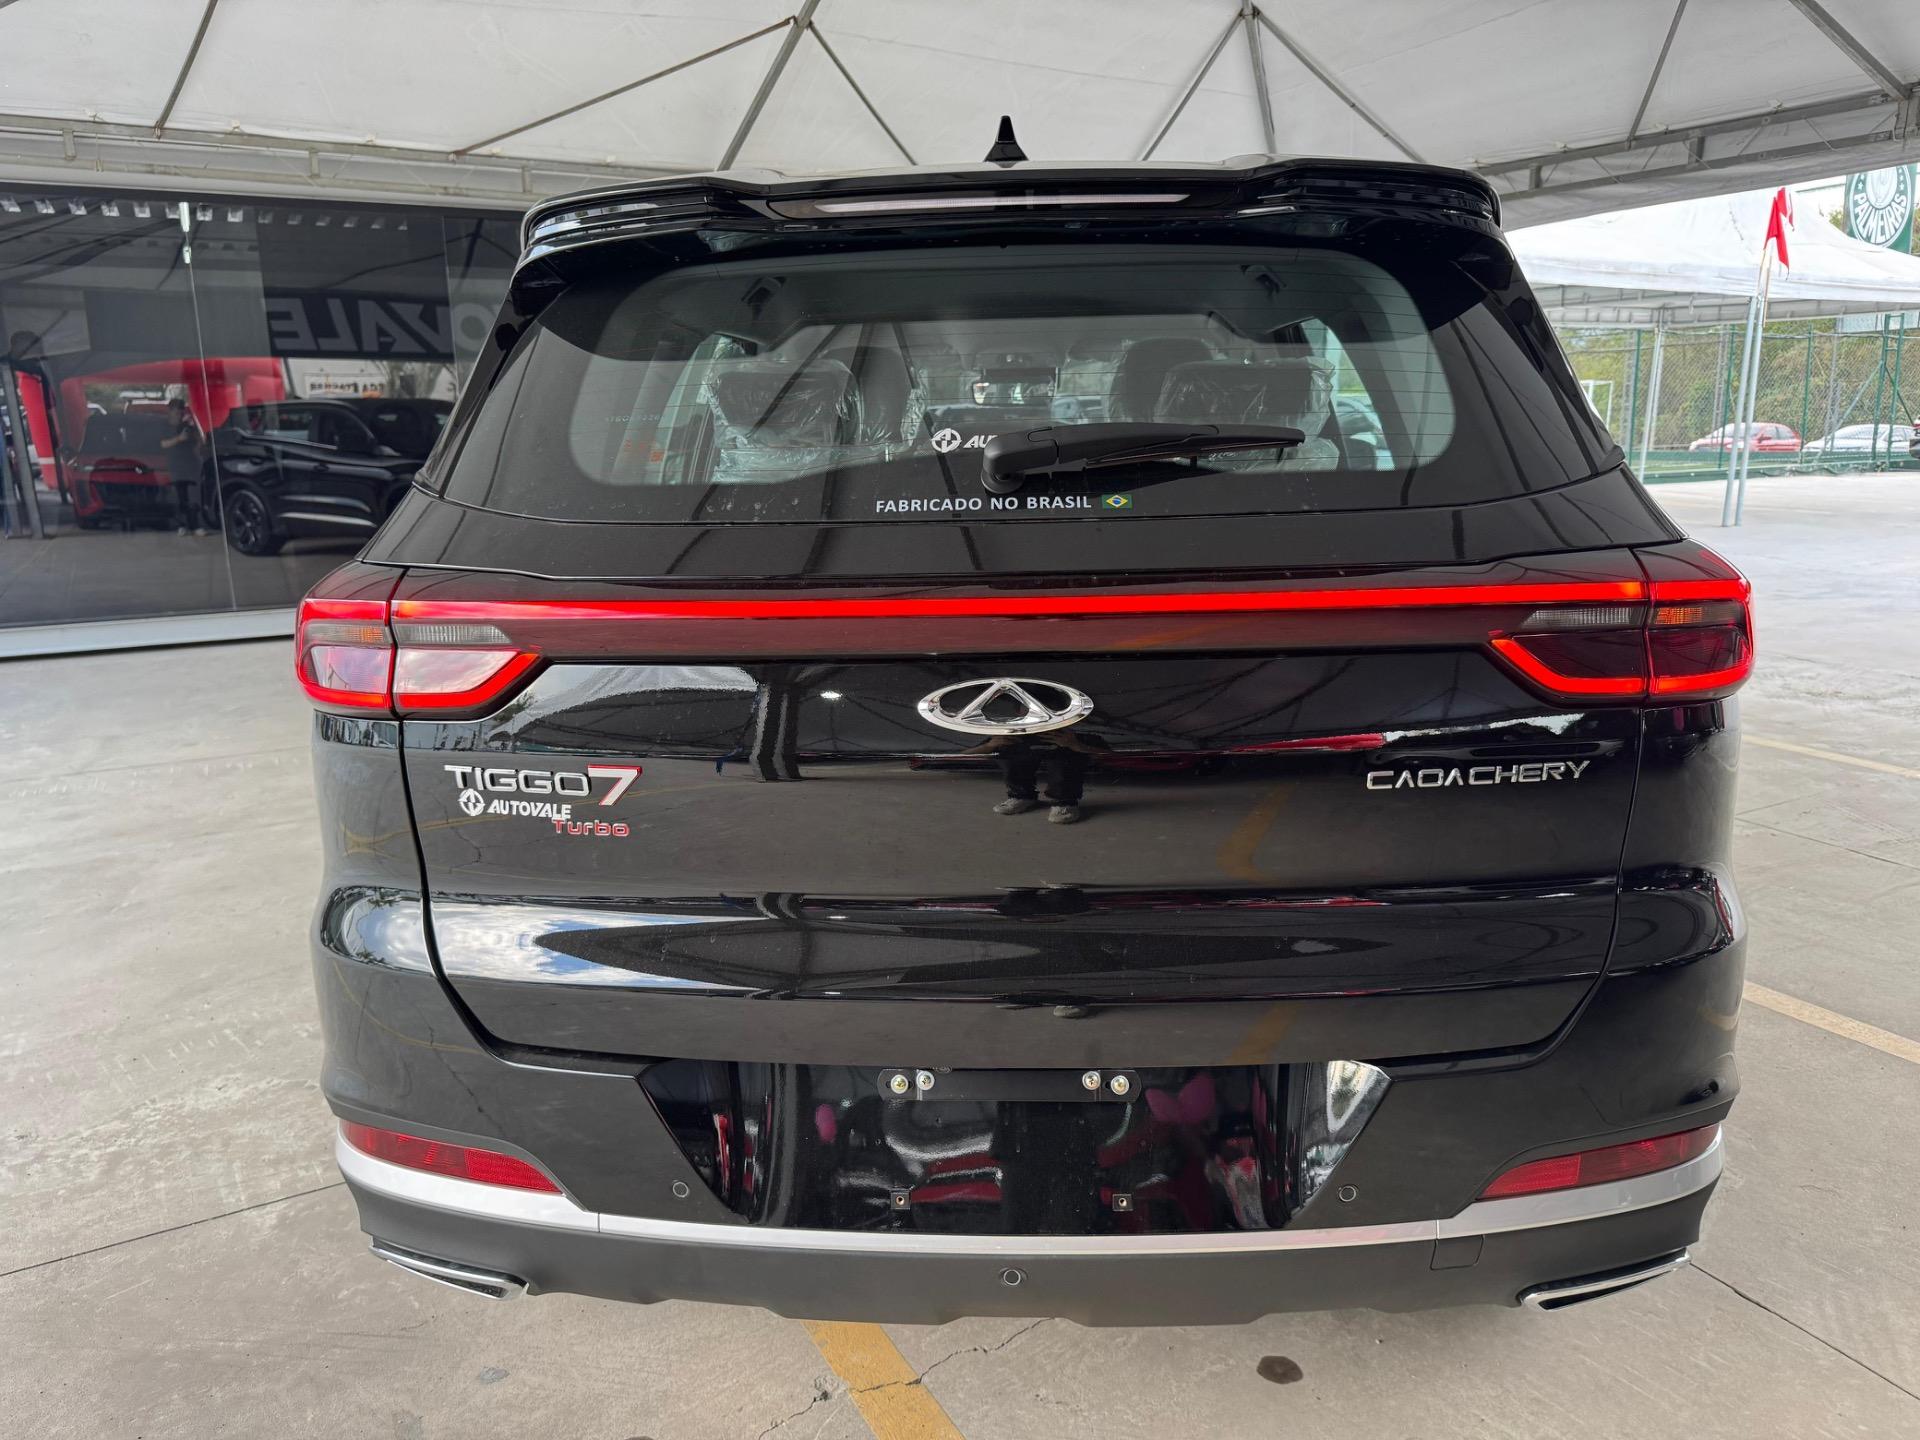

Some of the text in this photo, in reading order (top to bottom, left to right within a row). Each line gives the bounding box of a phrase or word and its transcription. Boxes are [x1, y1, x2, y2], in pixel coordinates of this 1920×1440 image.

[1854, 193, 1907, 244] PALMEIRAS
[876, 496, 1092, 513] FABRICADO NO BRASIL
[487, 799, 571, 819] AUTOVALE
[552, 817, 629, 837] Turbo
